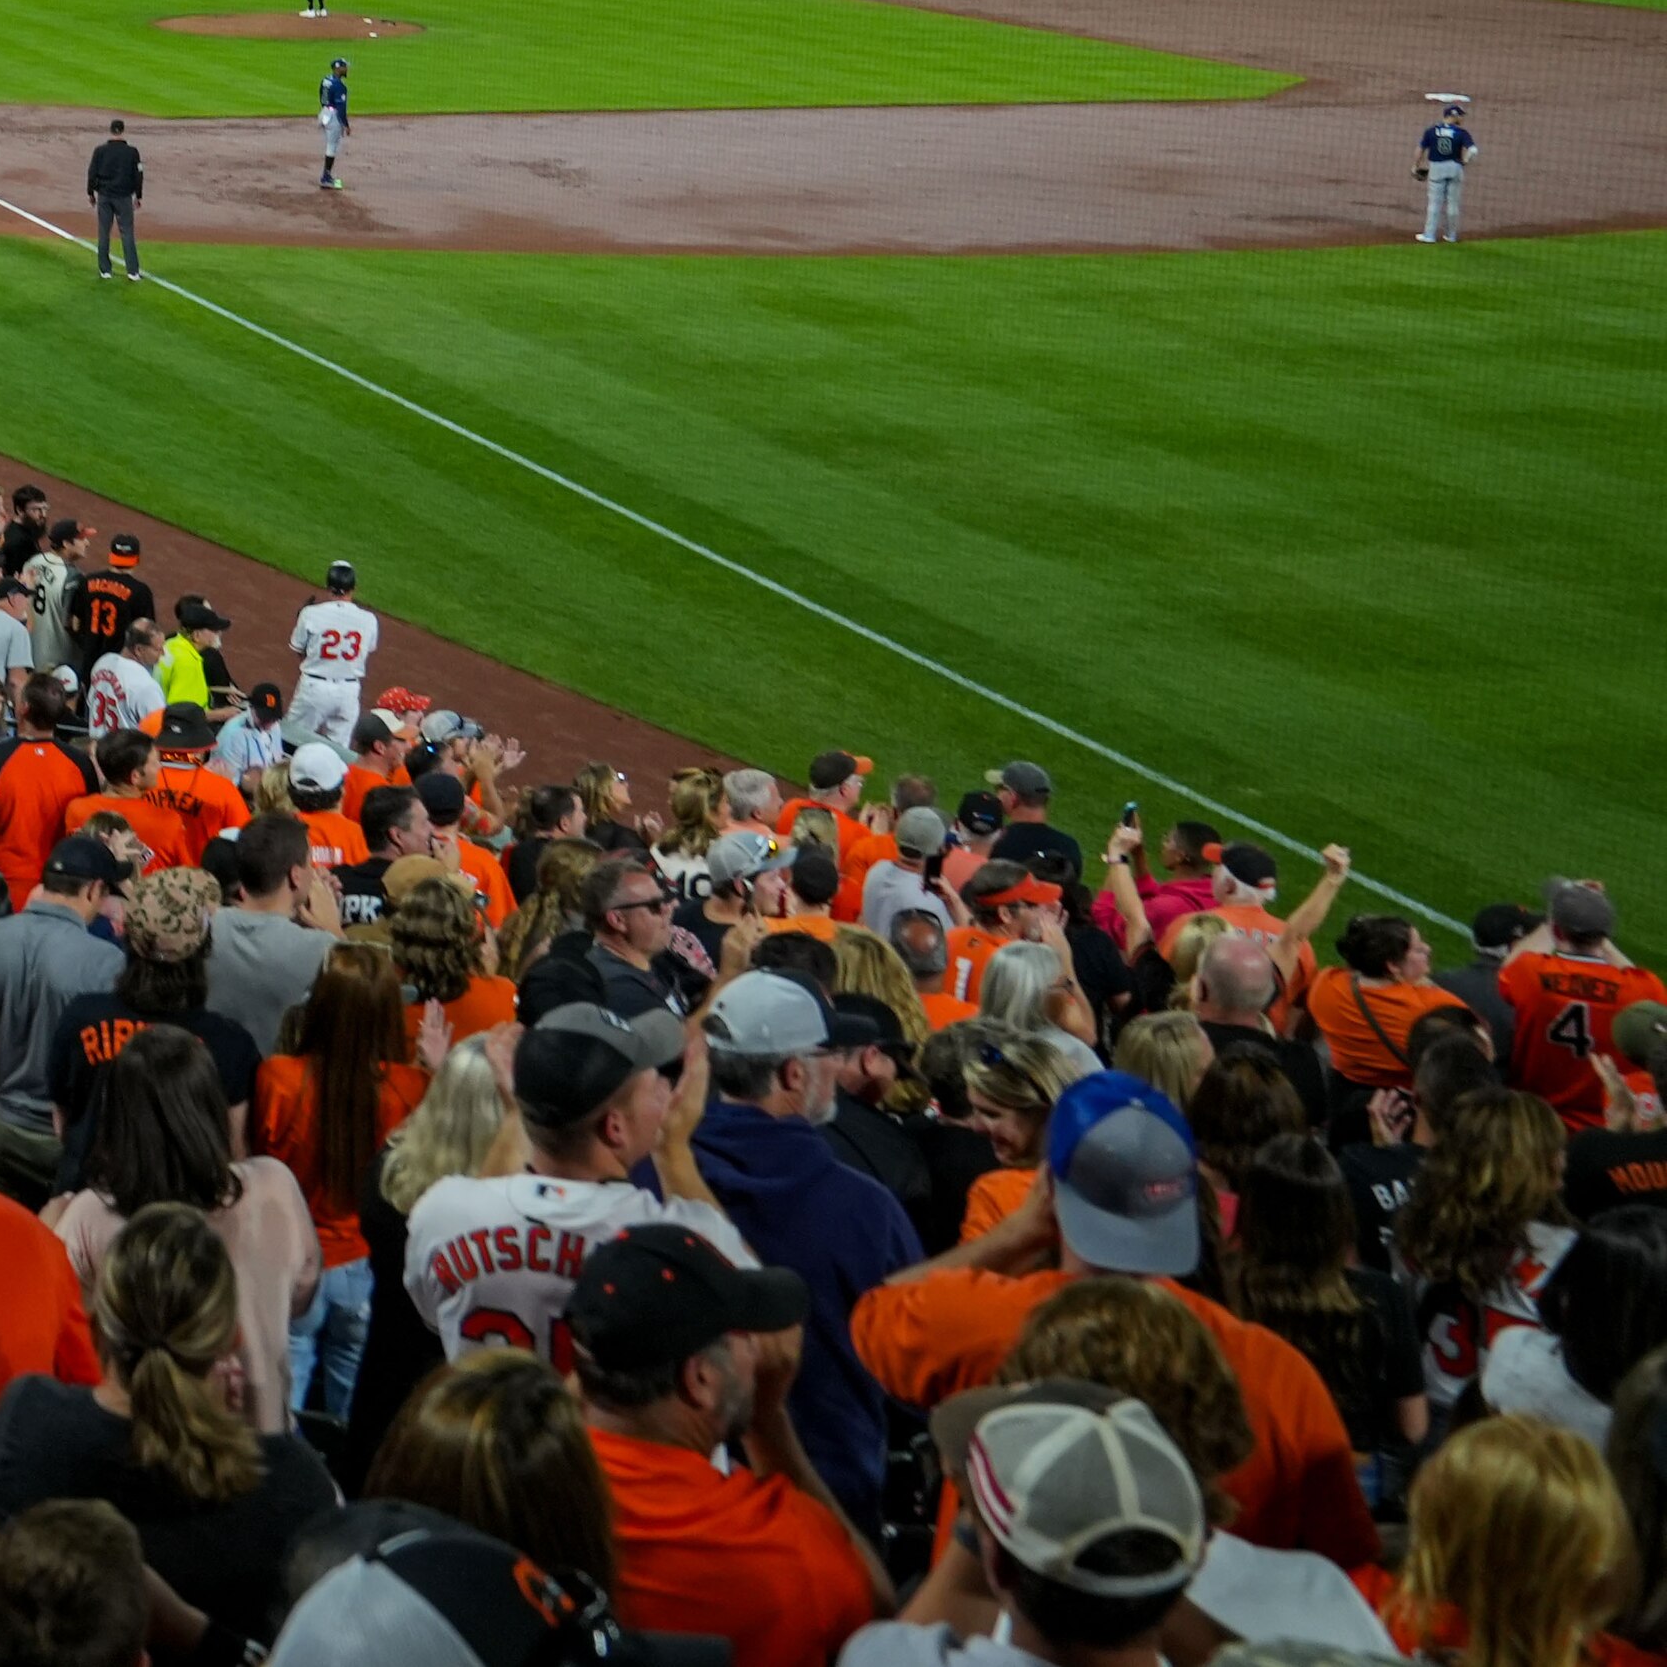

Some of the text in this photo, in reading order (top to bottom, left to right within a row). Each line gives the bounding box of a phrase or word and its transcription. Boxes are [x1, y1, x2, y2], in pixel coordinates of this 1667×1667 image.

[33, 584, 47, 616] 8
[87, 576, 132, 603] MACHADO
[90, 598, 118, 637] 13
[320, 629, 363, 662] 23
[93, 691, 120, 733] 35
[1538, 972, 1621, 1001] WEAVER
[1547, 1001, 1596, 1059] 4
[430, 1226, 586, 1294] RUTSCH
